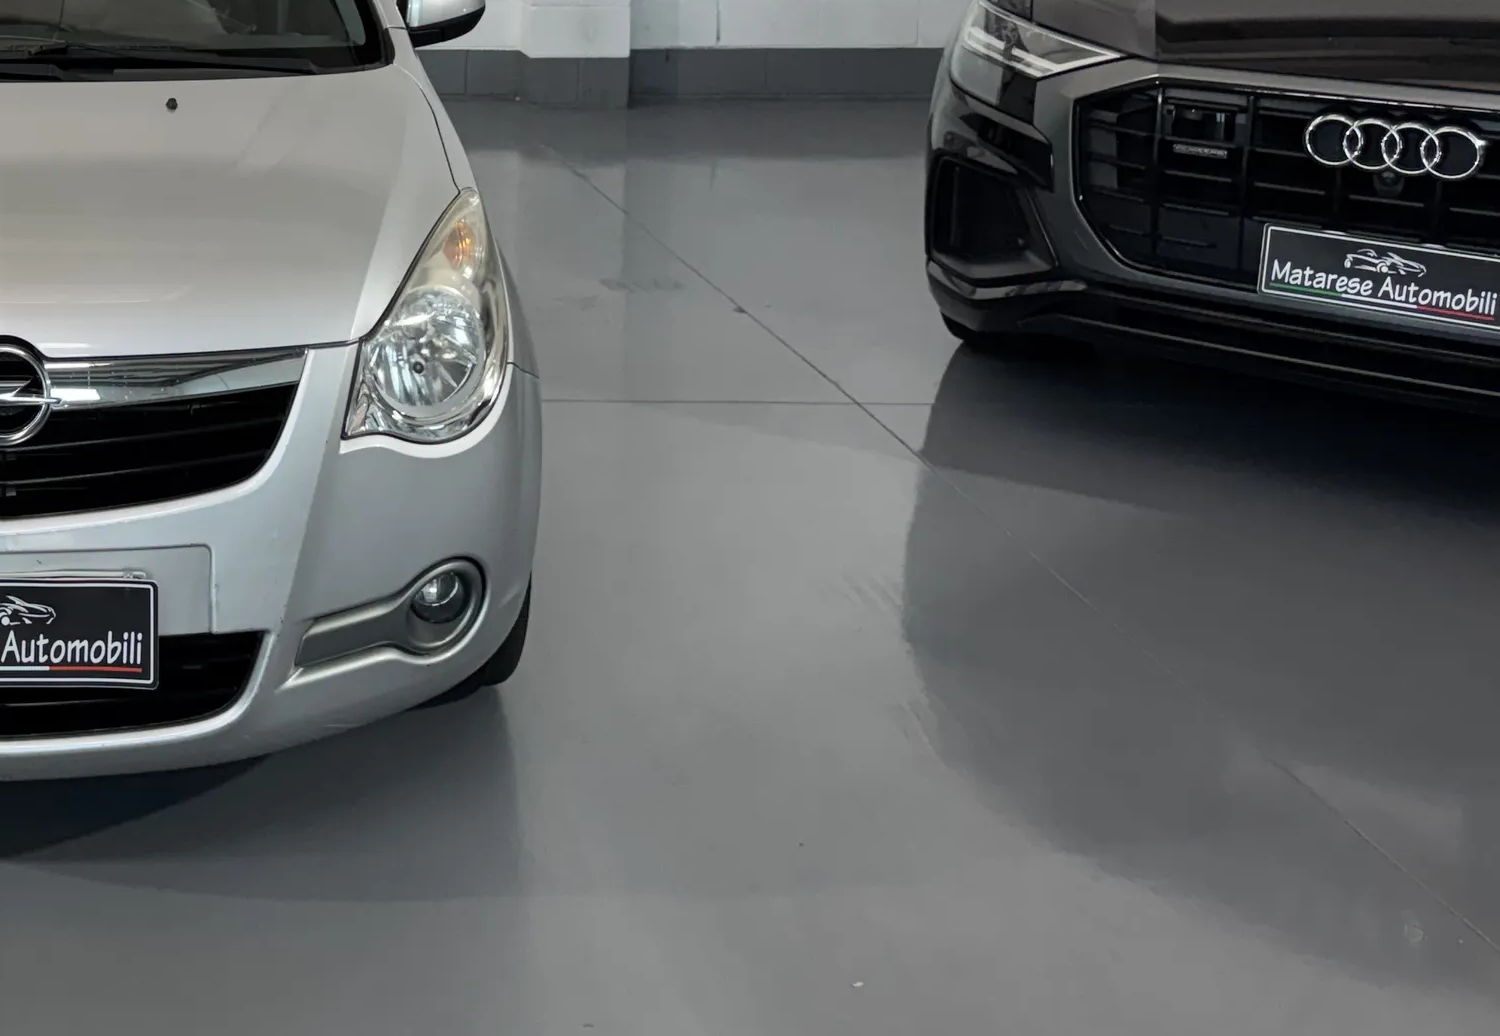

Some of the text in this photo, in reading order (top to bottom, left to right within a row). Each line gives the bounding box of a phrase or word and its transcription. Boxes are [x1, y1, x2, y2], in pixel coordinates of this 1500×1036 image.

[1271, 258, 1498, 316] Matarese Automobili
[0, 630, 143, 665] Automobili
